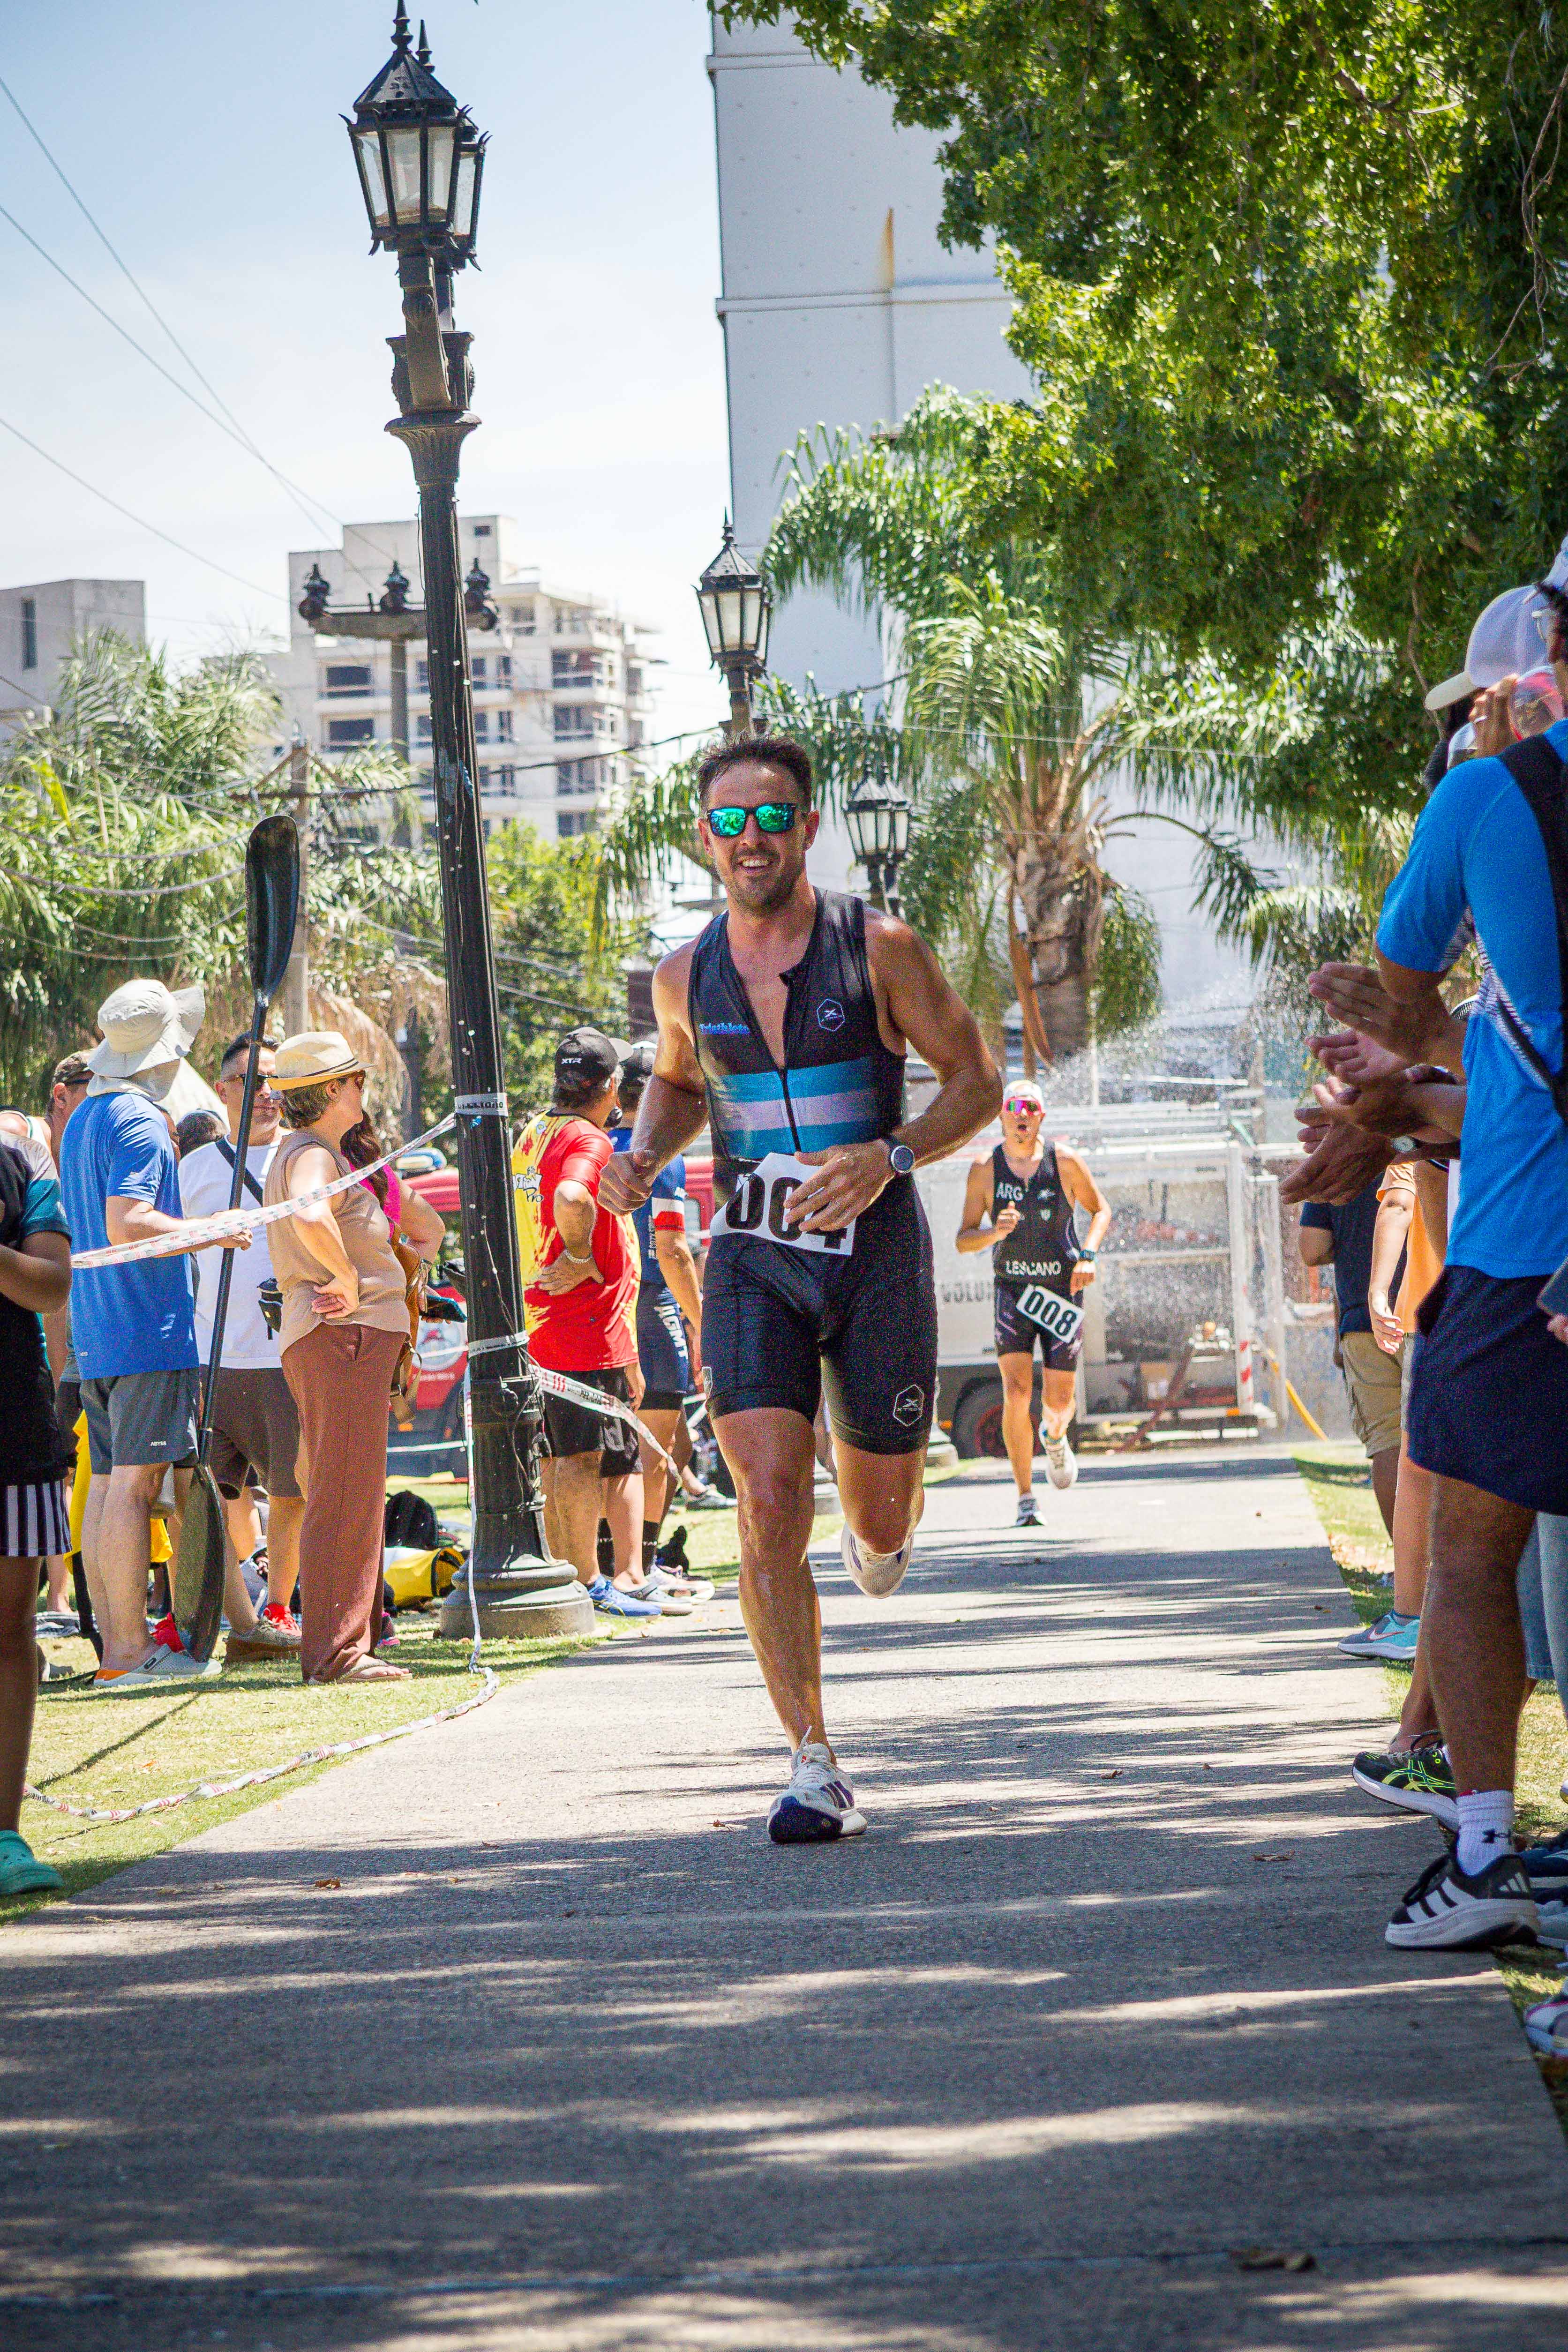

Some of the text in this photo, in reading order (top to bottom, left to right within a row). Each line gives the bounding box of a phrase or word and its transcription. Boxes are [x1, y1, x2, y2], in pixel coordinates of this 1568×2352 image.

[523, 1187, 544, 1203] Pro
[996, 1182, 1025, 1201] ARG
[1005, 1260, 1062, 1276] LESCANO
[1024, 1290, 1077, 1336] 008
